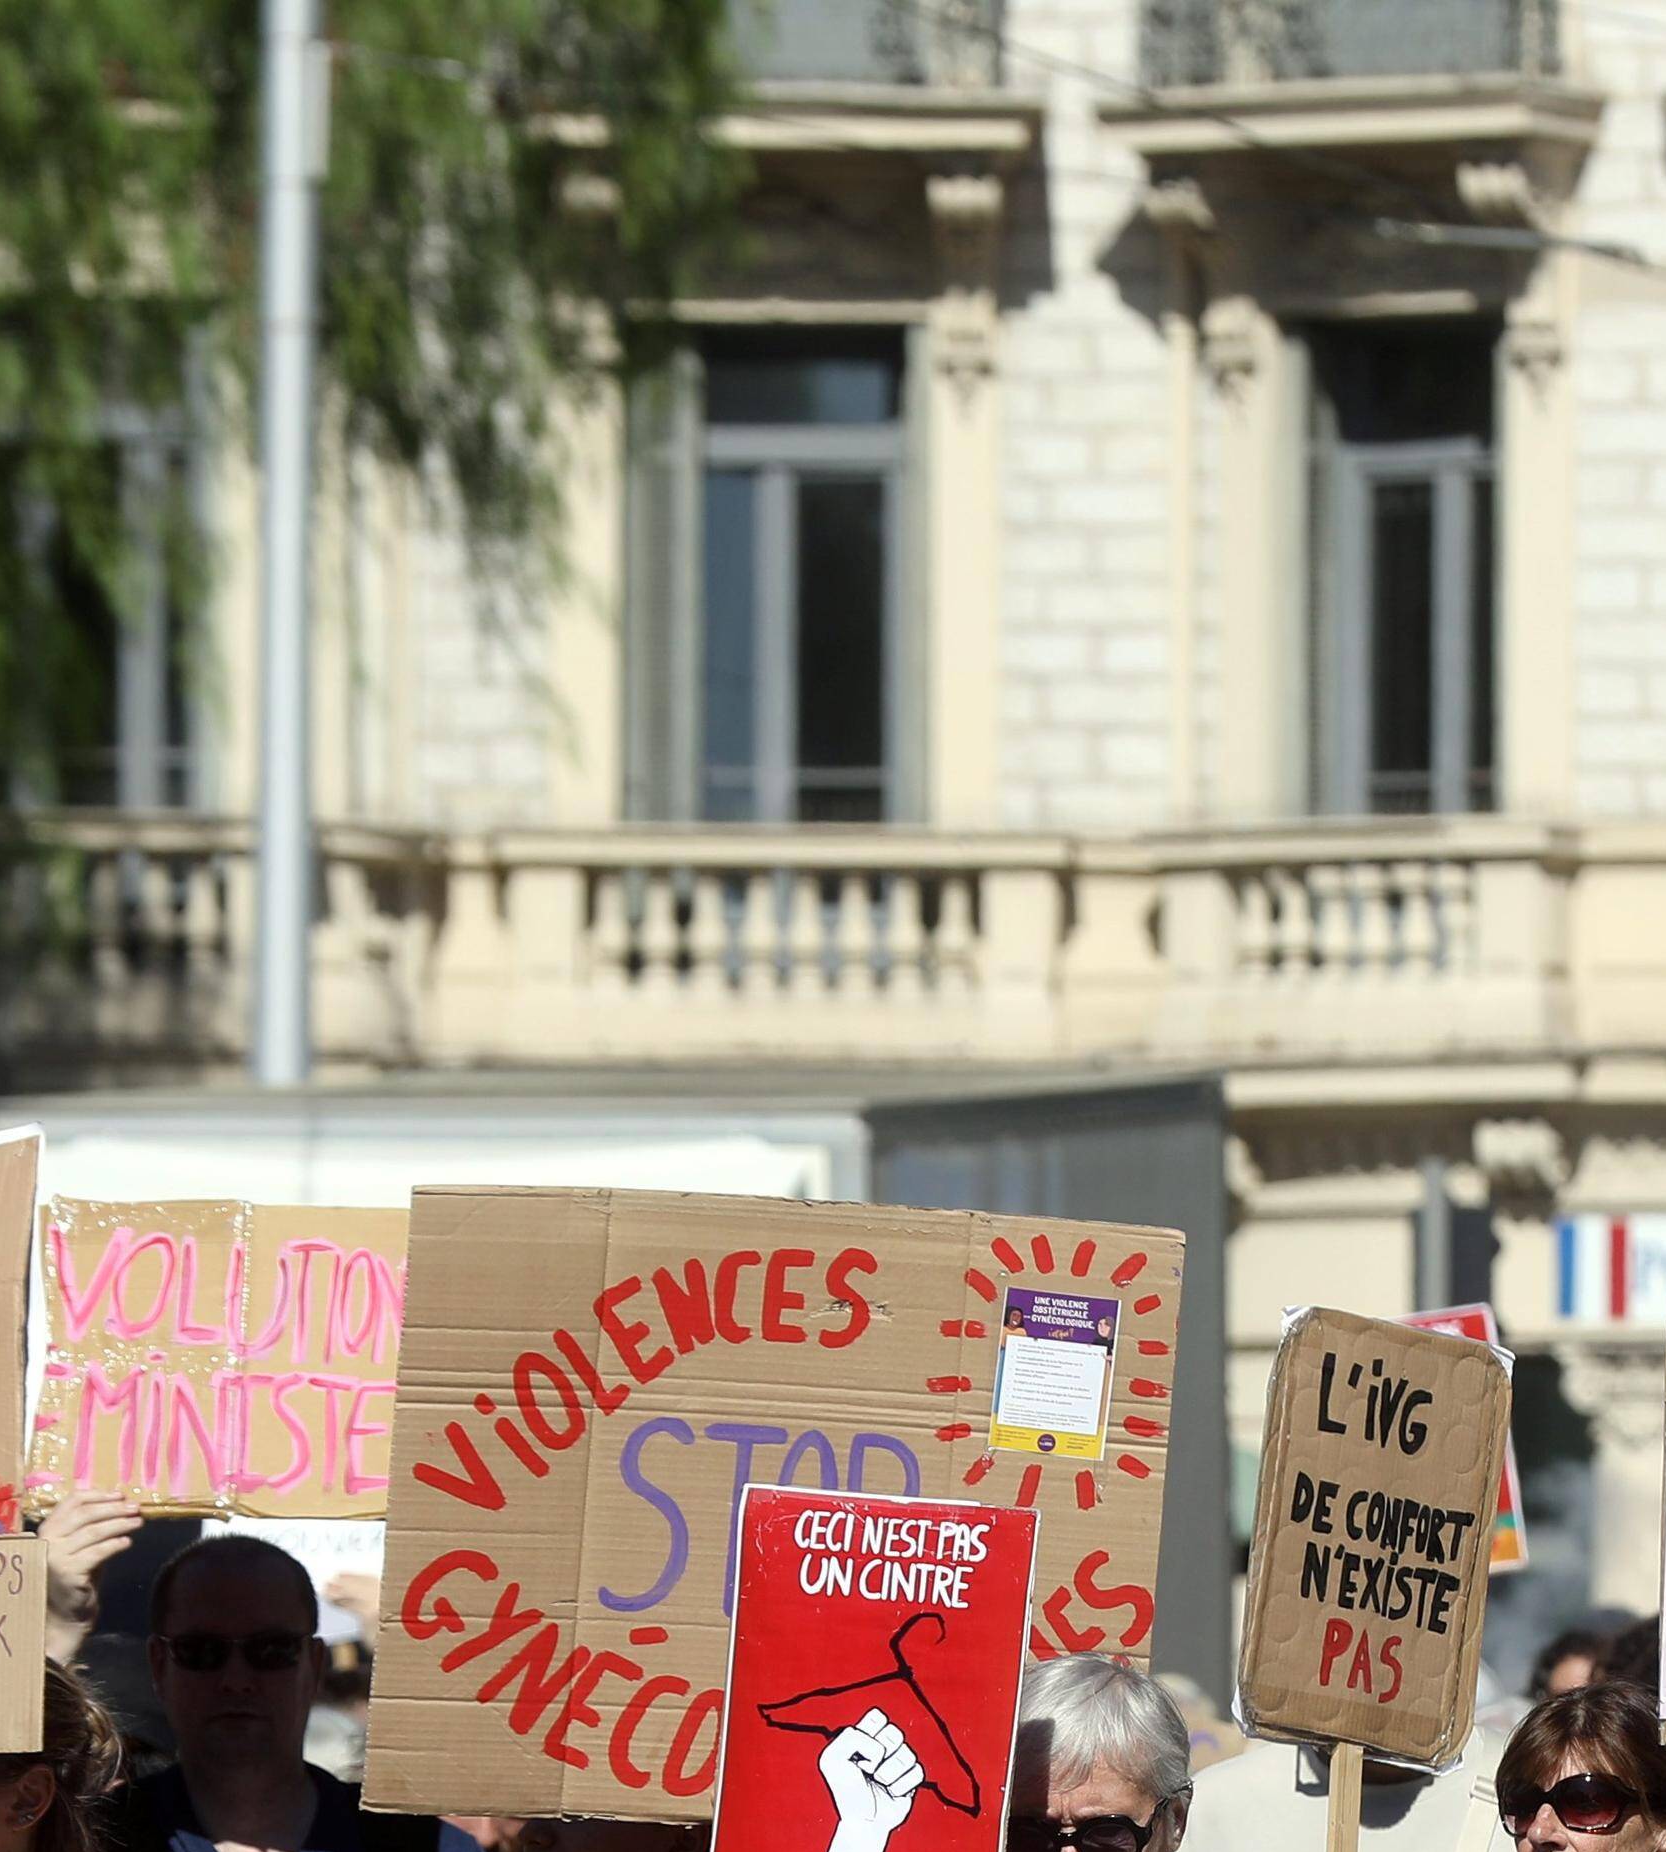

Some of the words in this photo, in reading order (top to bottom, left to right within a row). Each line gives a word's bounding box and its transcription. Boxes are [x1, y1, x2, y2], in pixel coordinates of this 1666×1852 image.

[1034, 1296, 1051, 1306] UNE
[1052, 1299, 1089, 1310] VIOLENCE
[794, 1510, 855, 1552] CECI
[861, 1515, 932, 1558] N'EST
[936, 1521, 990, 1562] PAS
[1291, 1471, 1334, 1528] DE
[1344, 1490, 1475, 1565] CONFORT
[800, 1553, 854, 1597] UN
[859, 1558, 974, 1609] CINTRE
[1318, 1618, 1404, 1704] PAS
